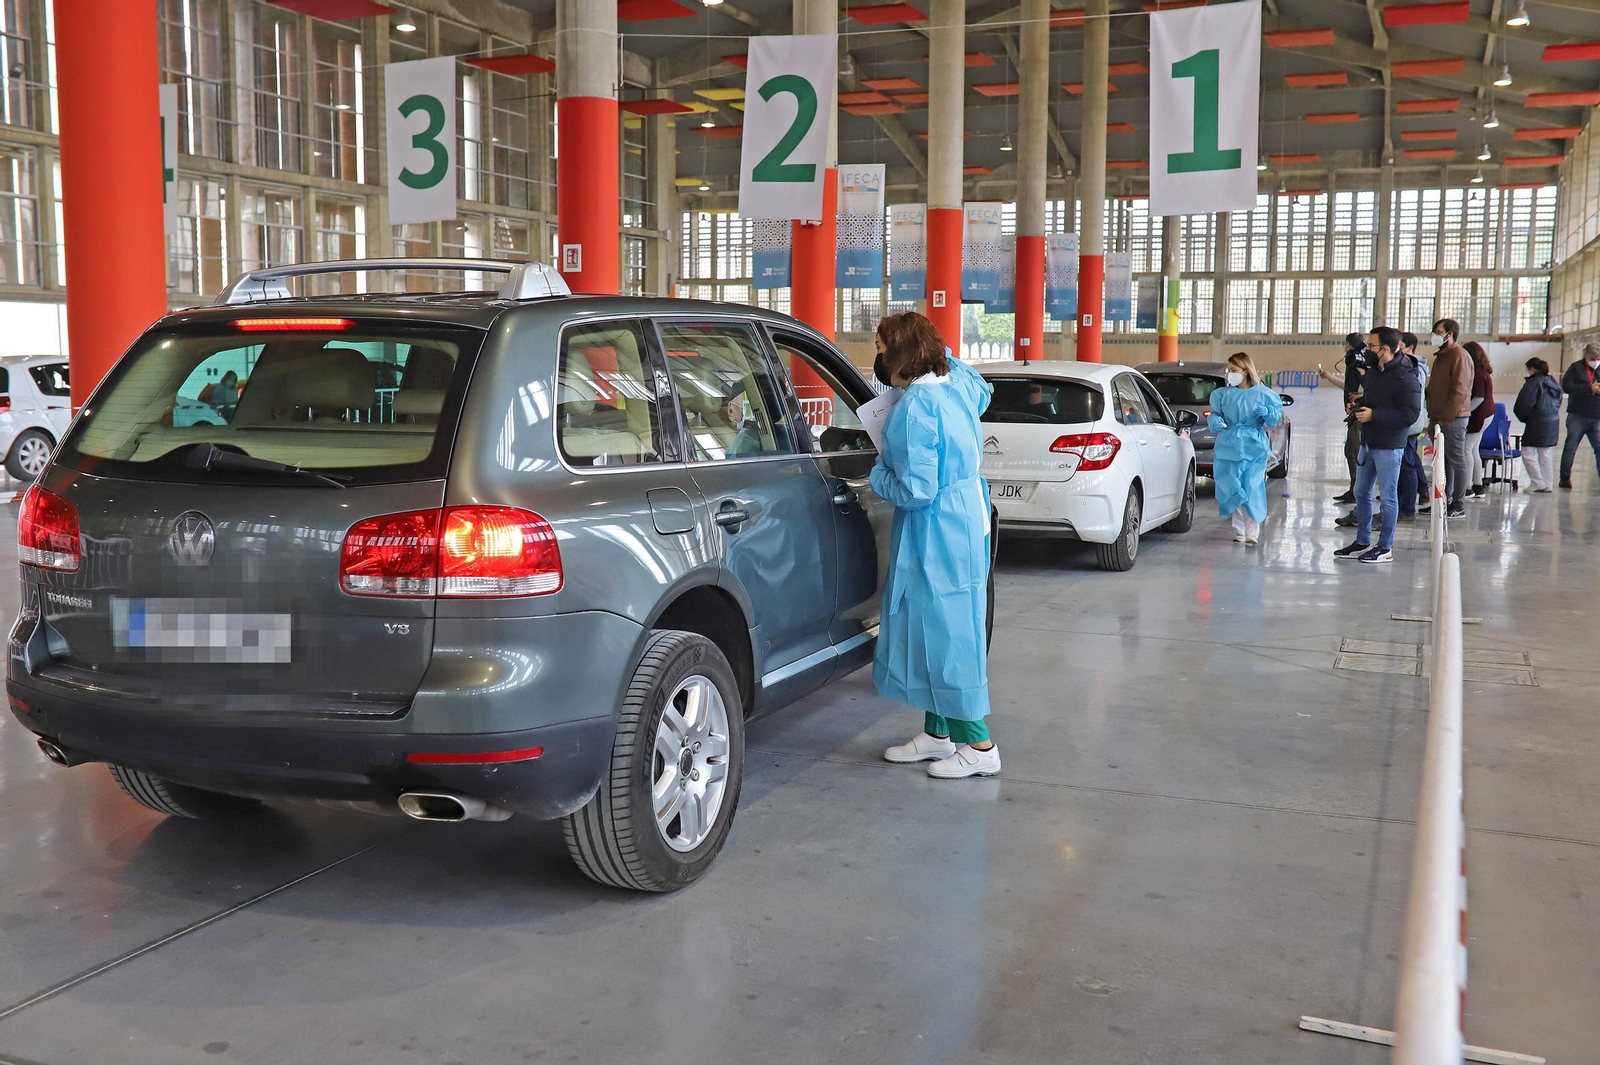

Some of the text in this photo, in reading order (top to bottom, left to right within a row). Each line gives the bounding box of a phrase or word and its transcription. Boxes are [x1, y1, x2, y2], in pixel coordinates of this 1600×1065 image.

[1167, 49, 1241, 174] 1
[752, 75, 817, 182] 2
[398, 94, 449, 190] 3
[842, 173, 880, 184] IFECA
[893, 211, 924, 220] IFECA
[967, 209, 998, 219] IFECA
[998, 485, 1022, 498] JDK
